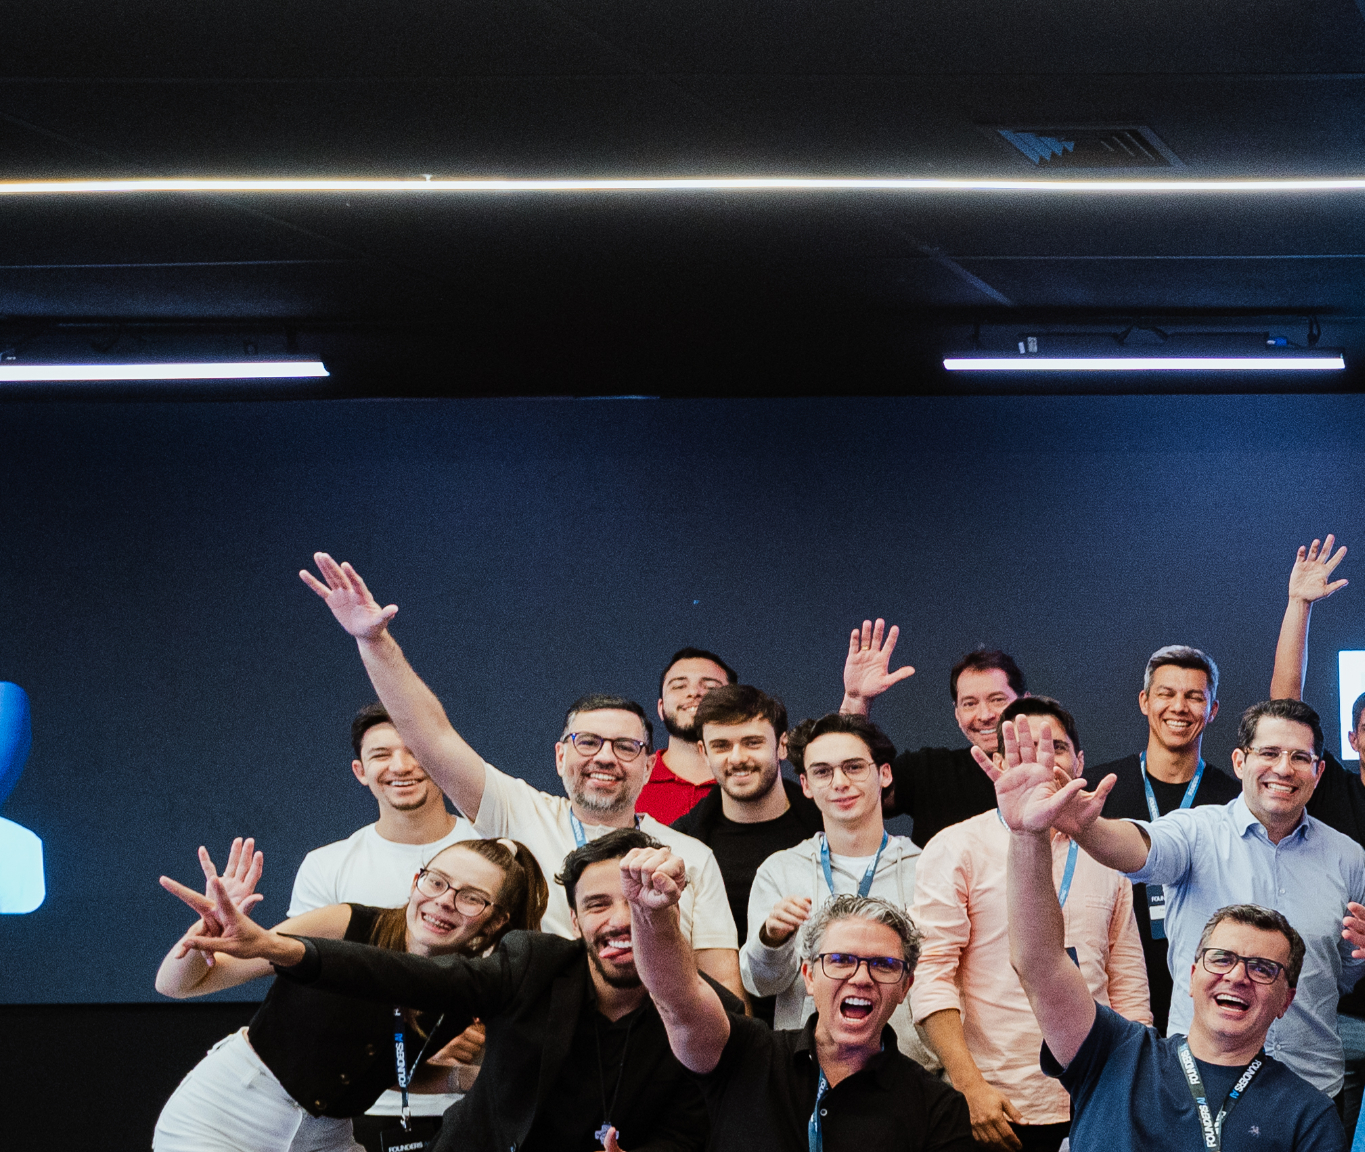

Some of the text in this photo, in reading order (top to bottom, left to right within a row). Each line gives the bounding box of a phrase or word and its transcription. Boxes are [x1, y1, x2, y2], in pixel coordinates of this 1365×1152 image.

[395, 1042, 407, 1088] FOUNDERS
[1181, 1049, 1200, 1085] FOUNDERS
[1229, 1060, 1262, 1099] FOUNDERS AI
[1196, 1097, 1216, 1148] FOUNDERS AI
